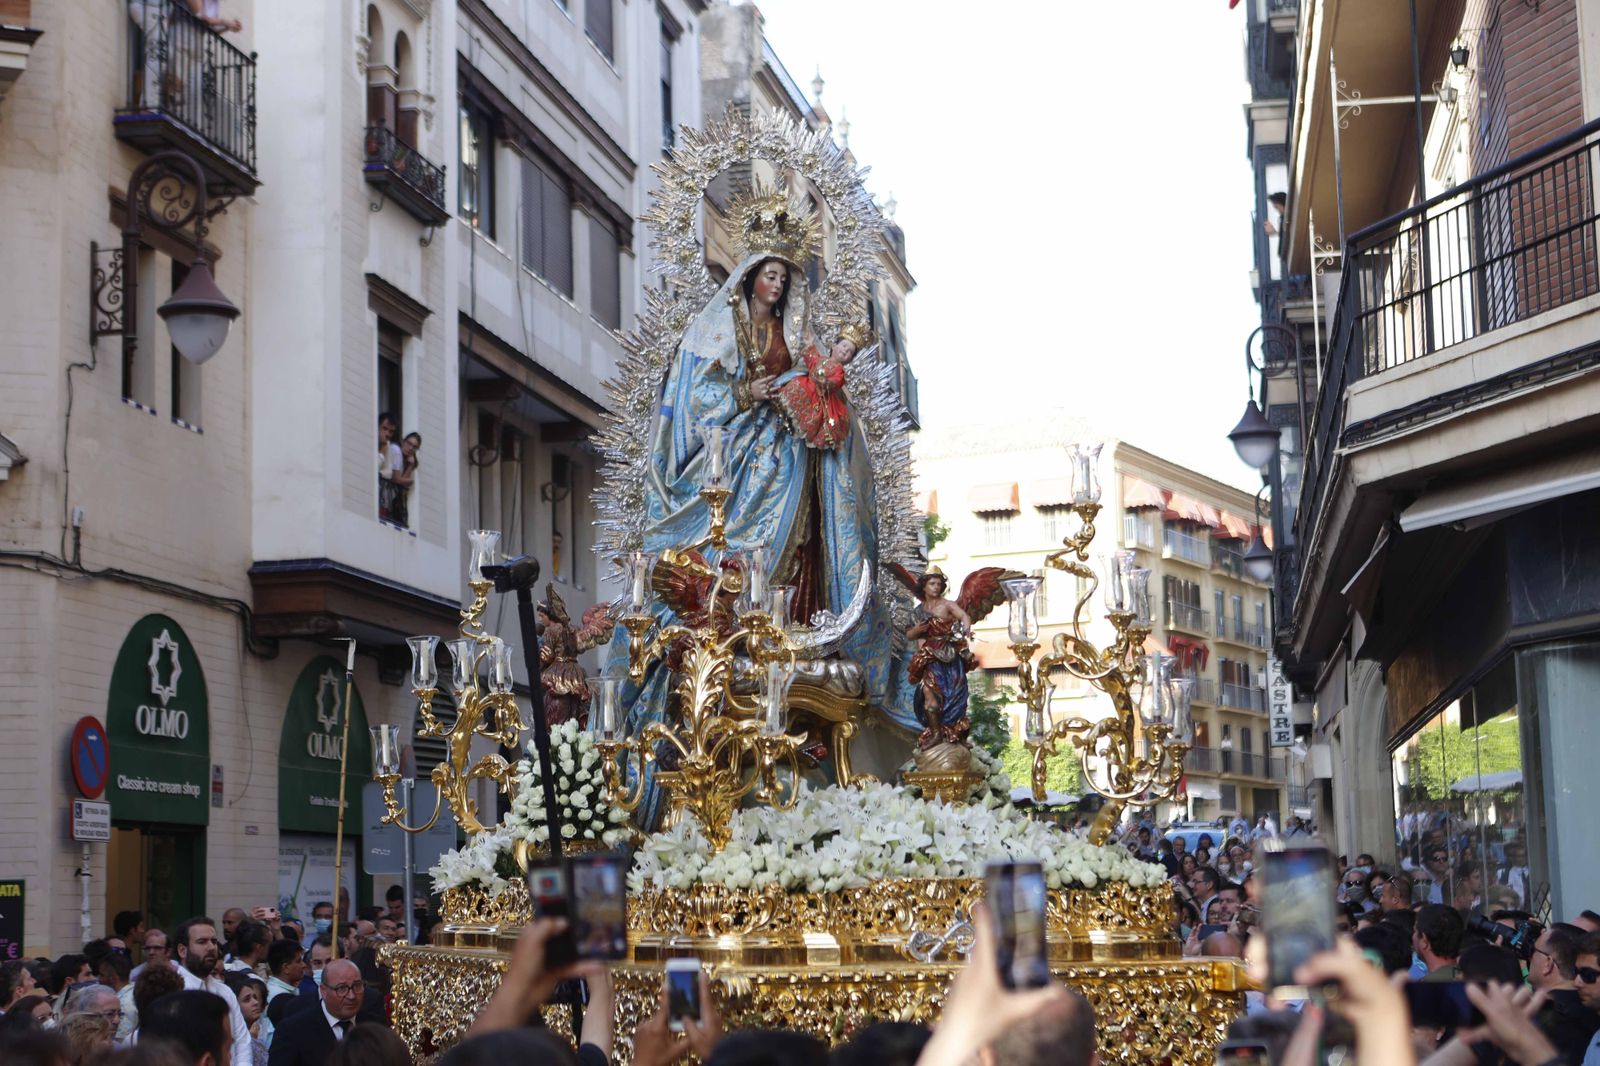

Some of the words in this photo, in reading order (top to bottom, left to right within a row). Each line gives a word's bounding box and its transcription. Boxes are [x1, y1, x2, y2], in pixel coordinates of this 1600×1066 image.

[1271, 660, 1290, 743] SASTRE
[135, 704, 189, 740] OLMO
[117, 774, 145, 791] Classic
[145, 777, 158, 792] ice
[158, 781, 182, 794] cream
[182, 780, 200, 799] shop
